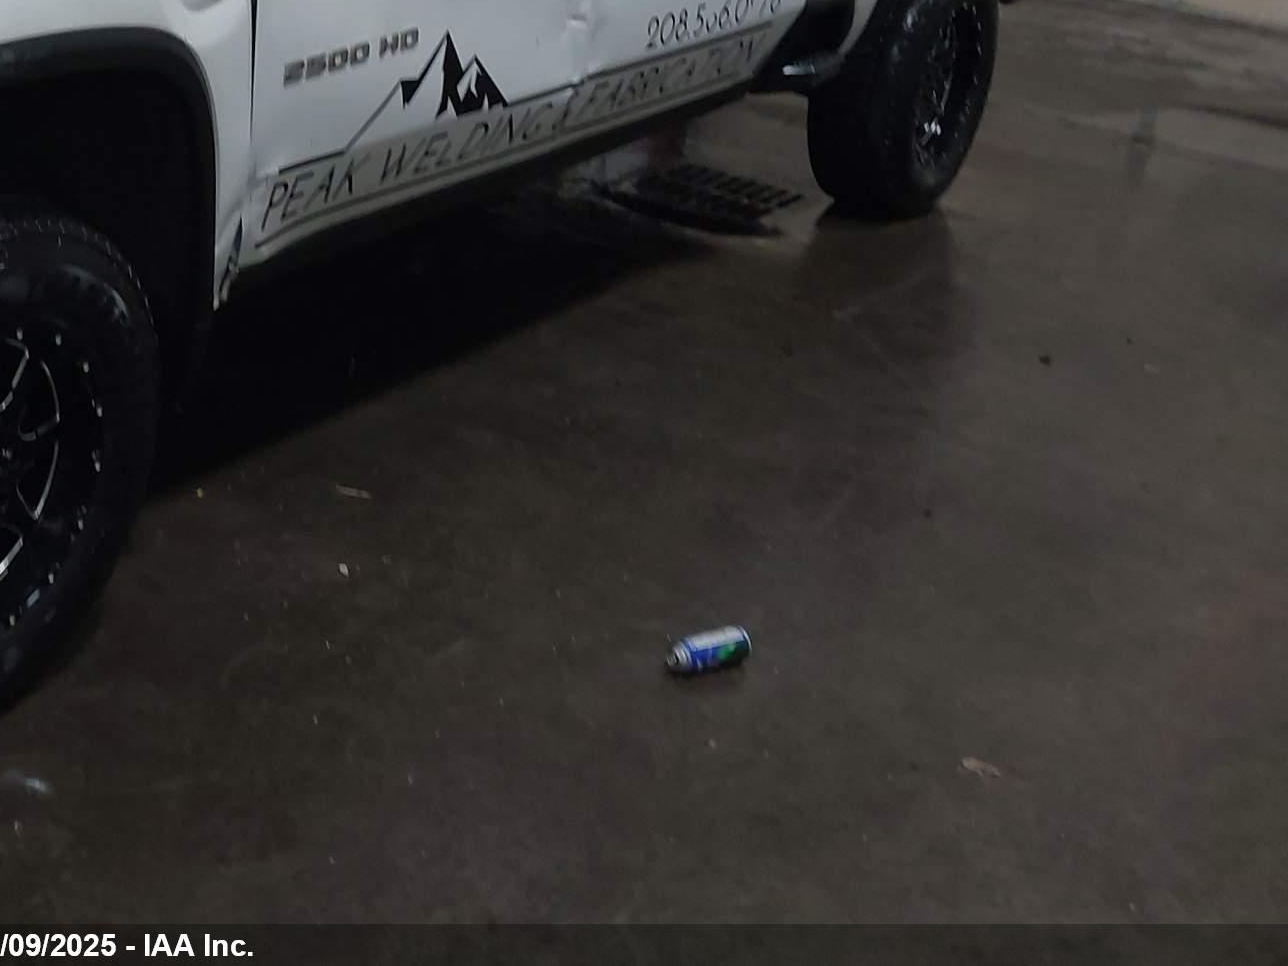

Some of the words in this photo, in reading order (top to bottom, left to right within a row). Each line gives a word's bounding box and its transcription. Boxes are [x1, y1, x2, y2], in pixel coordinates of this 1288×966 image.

[283, 41, 370, 87] 2500
[378, 26, 419, 58] HD
[261, 152, 372, 230] PEAK
[380, 101, 554, 183] WELDING
